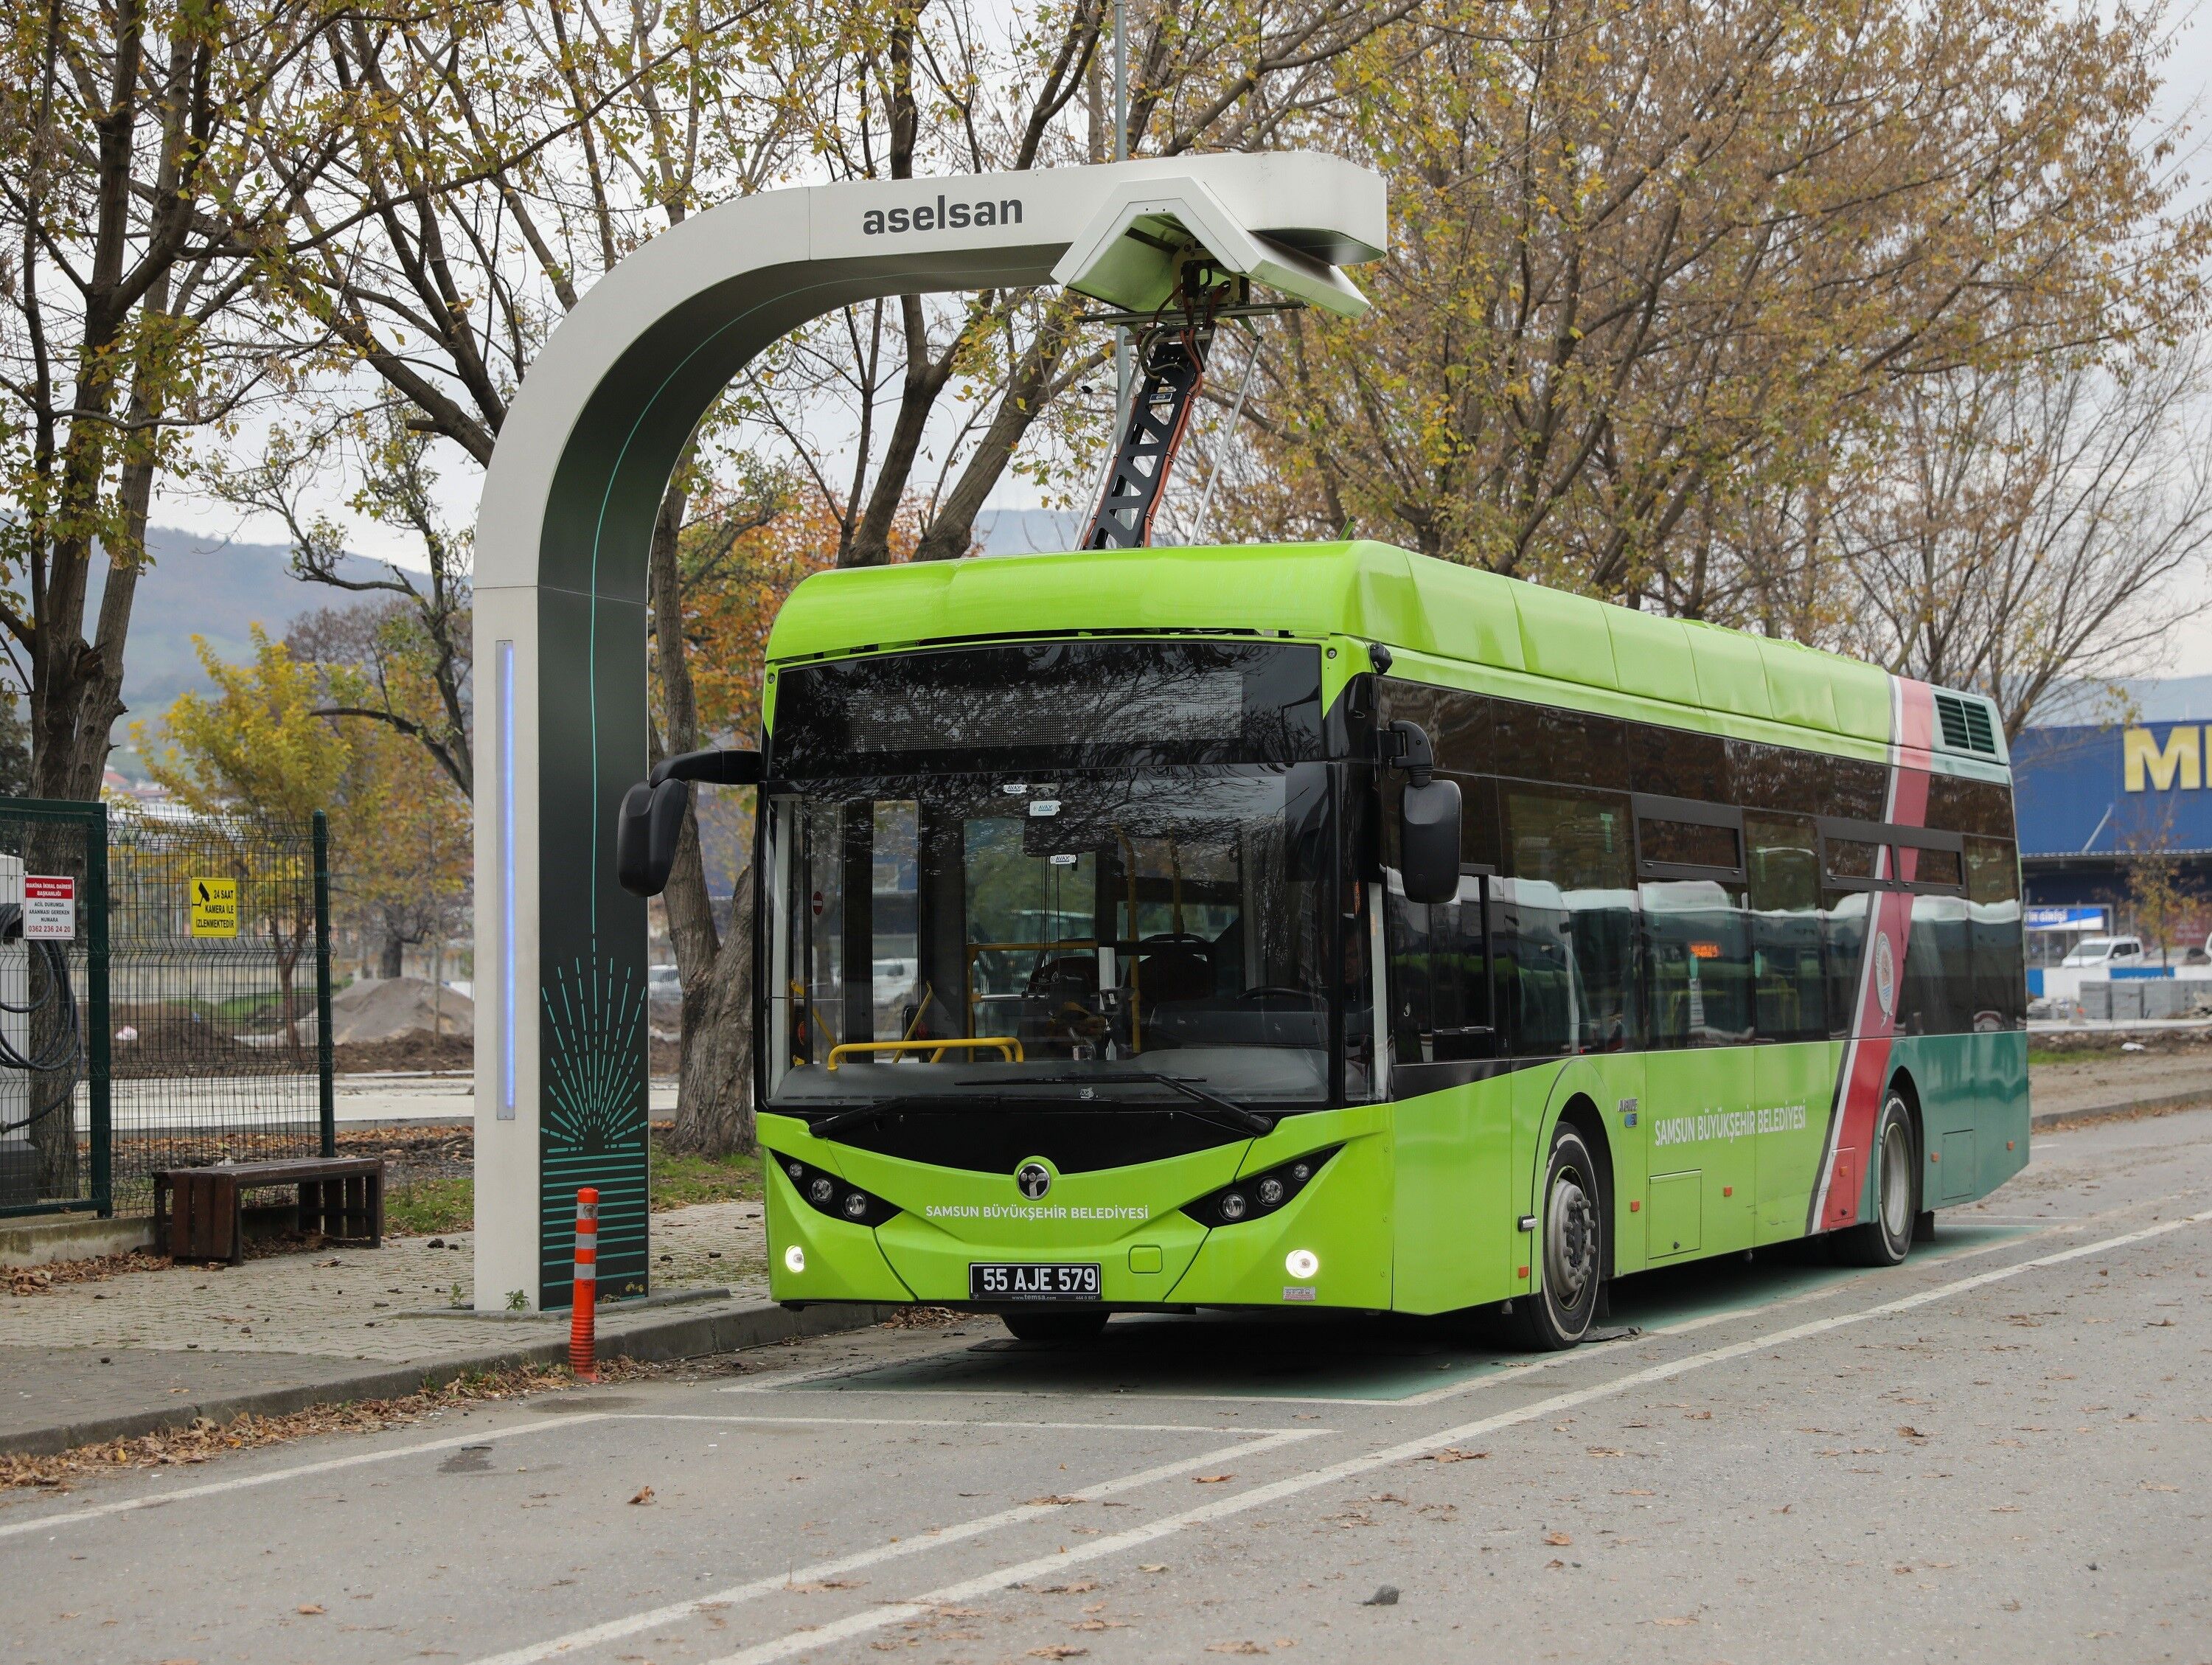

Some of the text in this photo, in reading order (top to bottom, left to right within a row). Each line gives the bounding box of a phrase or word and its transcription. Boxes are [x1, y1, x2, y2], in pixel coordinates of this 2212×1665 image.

[863, 195, 1023, 235] aselsan
[214, 889, 234, 900] 24 SAAT
[205, 903, 234, 914] KAMERA İLE
[196, 917, 234, 928] İZLENMEKTEDİR
[1655, 1099, 1806, 1146] SAMSUN BÜYÜKŞEHİR BELEDİYESİ
[925, 1203, 1149, 1221] SAMSUN BÜYÜKŞEHİR BELEDİYESİ
[983, 1268, 1096, 1291] 55 AJE 579
